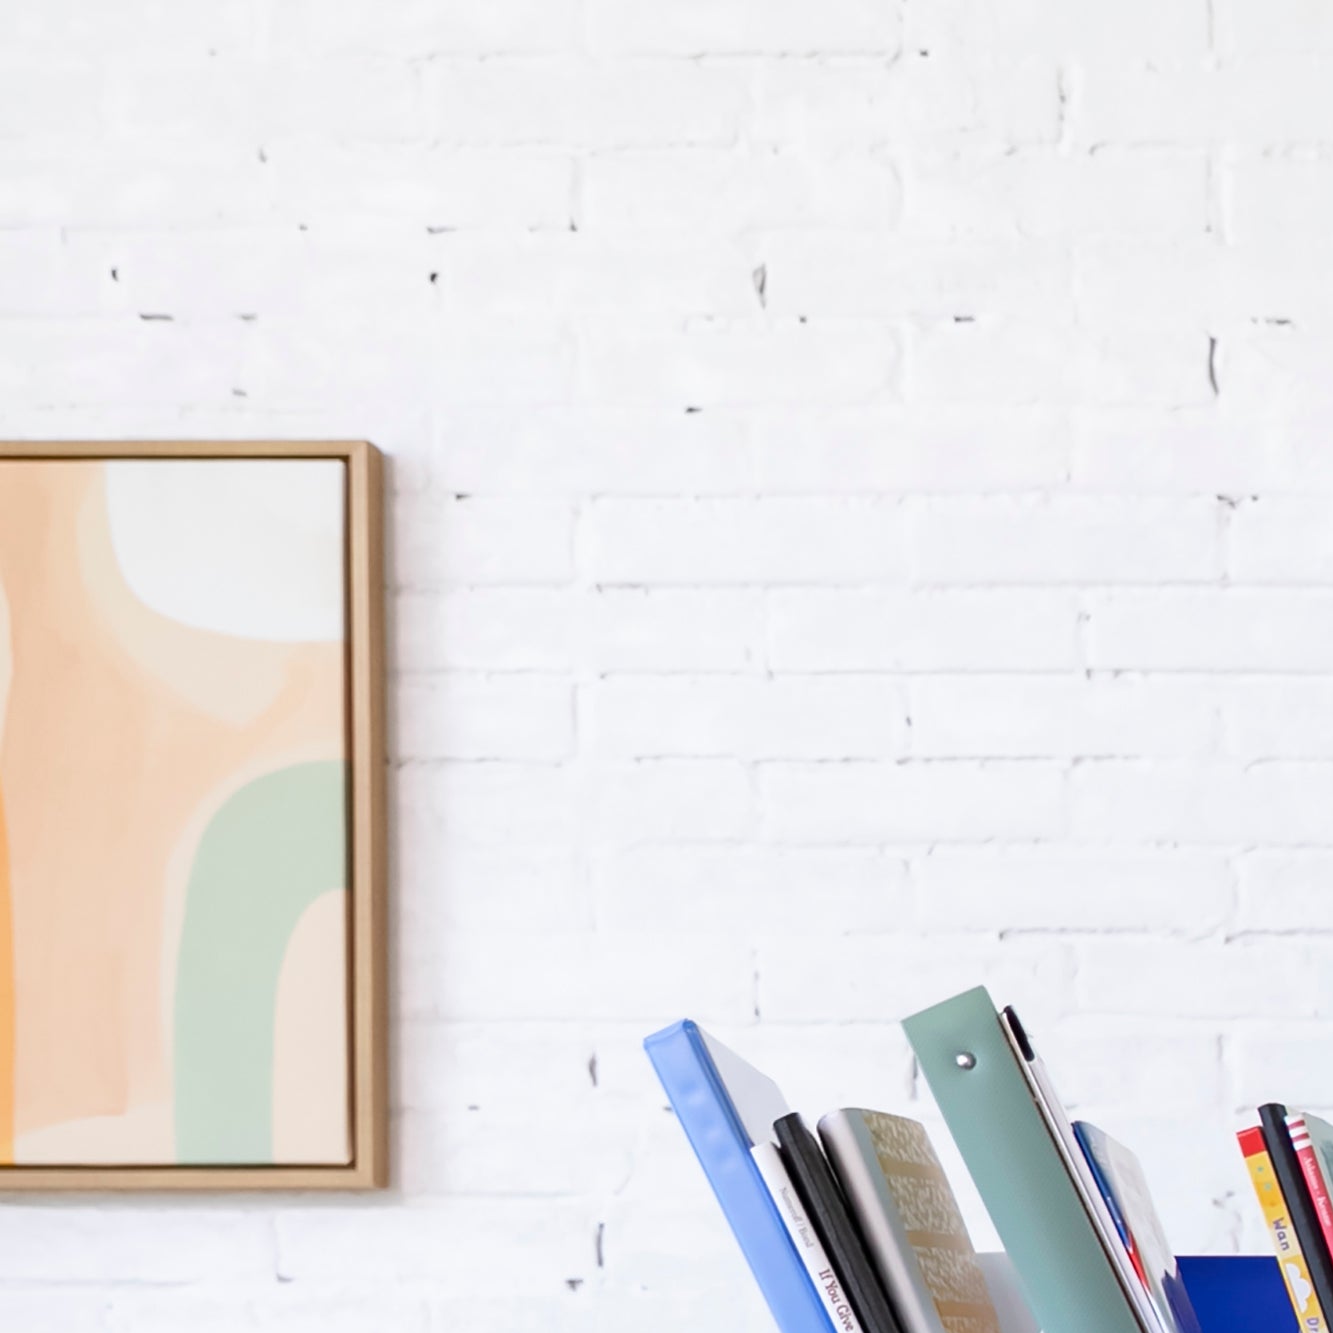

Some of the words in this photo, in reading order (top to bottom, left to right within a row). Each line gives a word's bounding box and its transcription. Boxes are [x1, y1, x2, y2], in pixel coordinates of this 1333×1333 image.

[1272, 1217, 1290, 1251] Wan
[818, 1268, 833, 1280] If
[825, 1280, 840, 1304] You
[836, 1304, 853, 1332] Give
